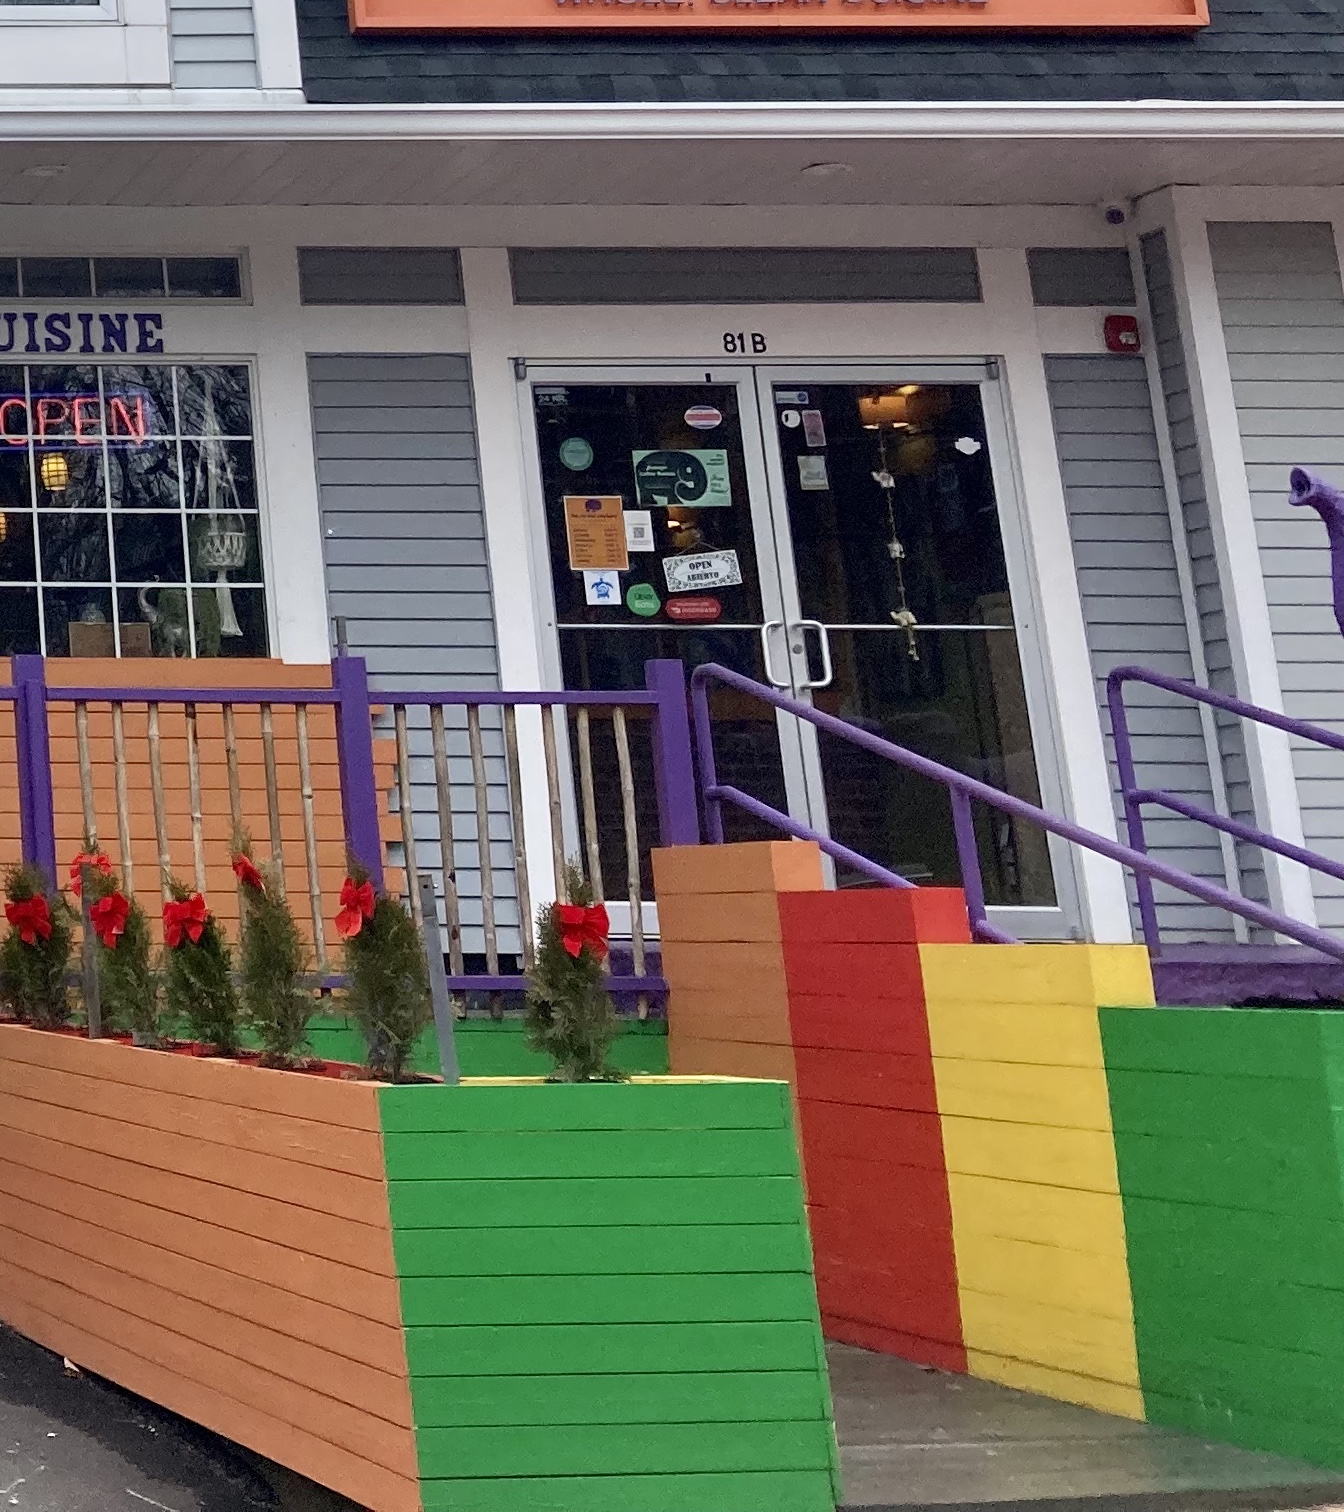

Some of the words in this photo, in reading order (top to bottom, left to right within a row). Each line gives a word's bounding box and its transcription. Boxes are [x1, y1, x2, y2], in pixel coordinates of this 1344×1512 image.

[723, 332, 746, 353] 81
[751, 332, 767, 353] B
[689, 560, 713, 571] OPEN
